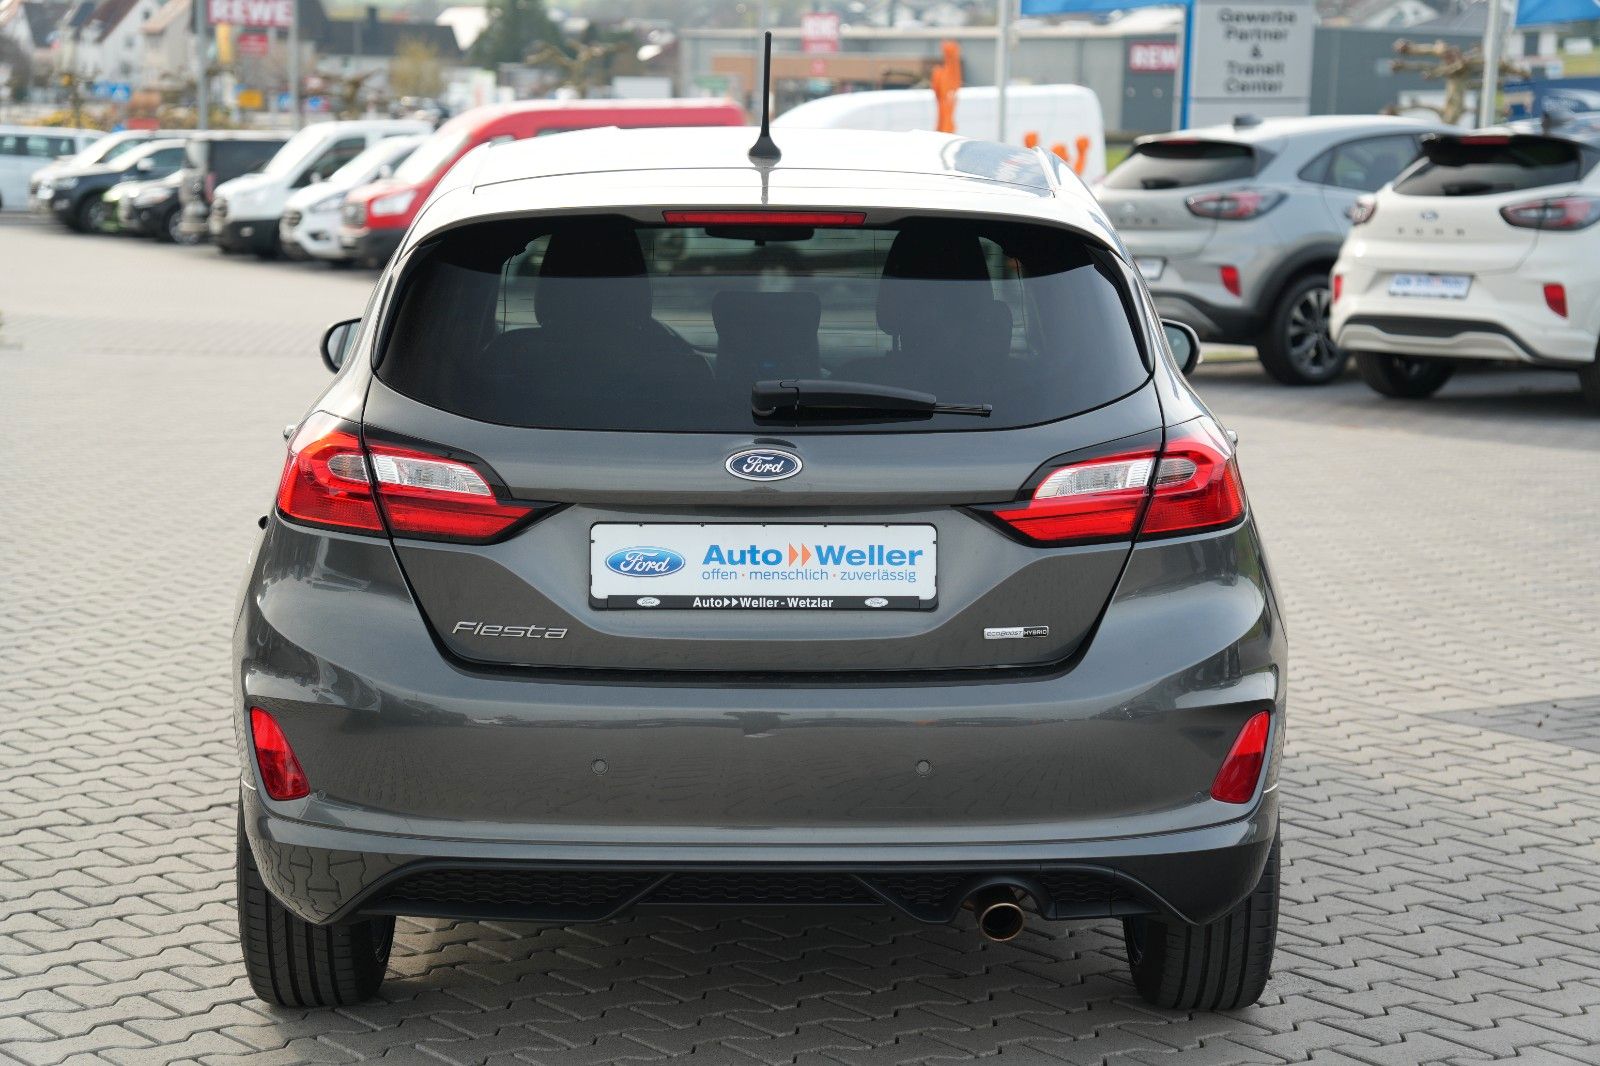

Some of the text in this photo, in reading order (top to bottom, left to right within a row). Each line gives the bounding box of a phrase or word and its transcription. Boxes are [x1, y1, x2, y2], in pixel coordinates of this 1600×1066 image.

[209, 0, 293, 25] REWE
[1219, 7, 1296, 23] Gewerbe
[1225, 26, 1287, 40] Partner
[1133, 46, 1177, 67] REW
[1227, 61, 1284, 76] Transit
[1224, 78, 1283, 93] Center
[742, 455, 784, 473] Ford
[619, 551, 671, 572] Ford
[702, 544, 923, 566] Auto Weller
[702, 568, 916, 583] offen menschlich zuverlässig
[693, 597, 723, 608] Auto
[740, 597, 779, 608] Weller
[787, 597, 834, 608] Wetzlar
[451, 621, 569, 639] Fiesta
